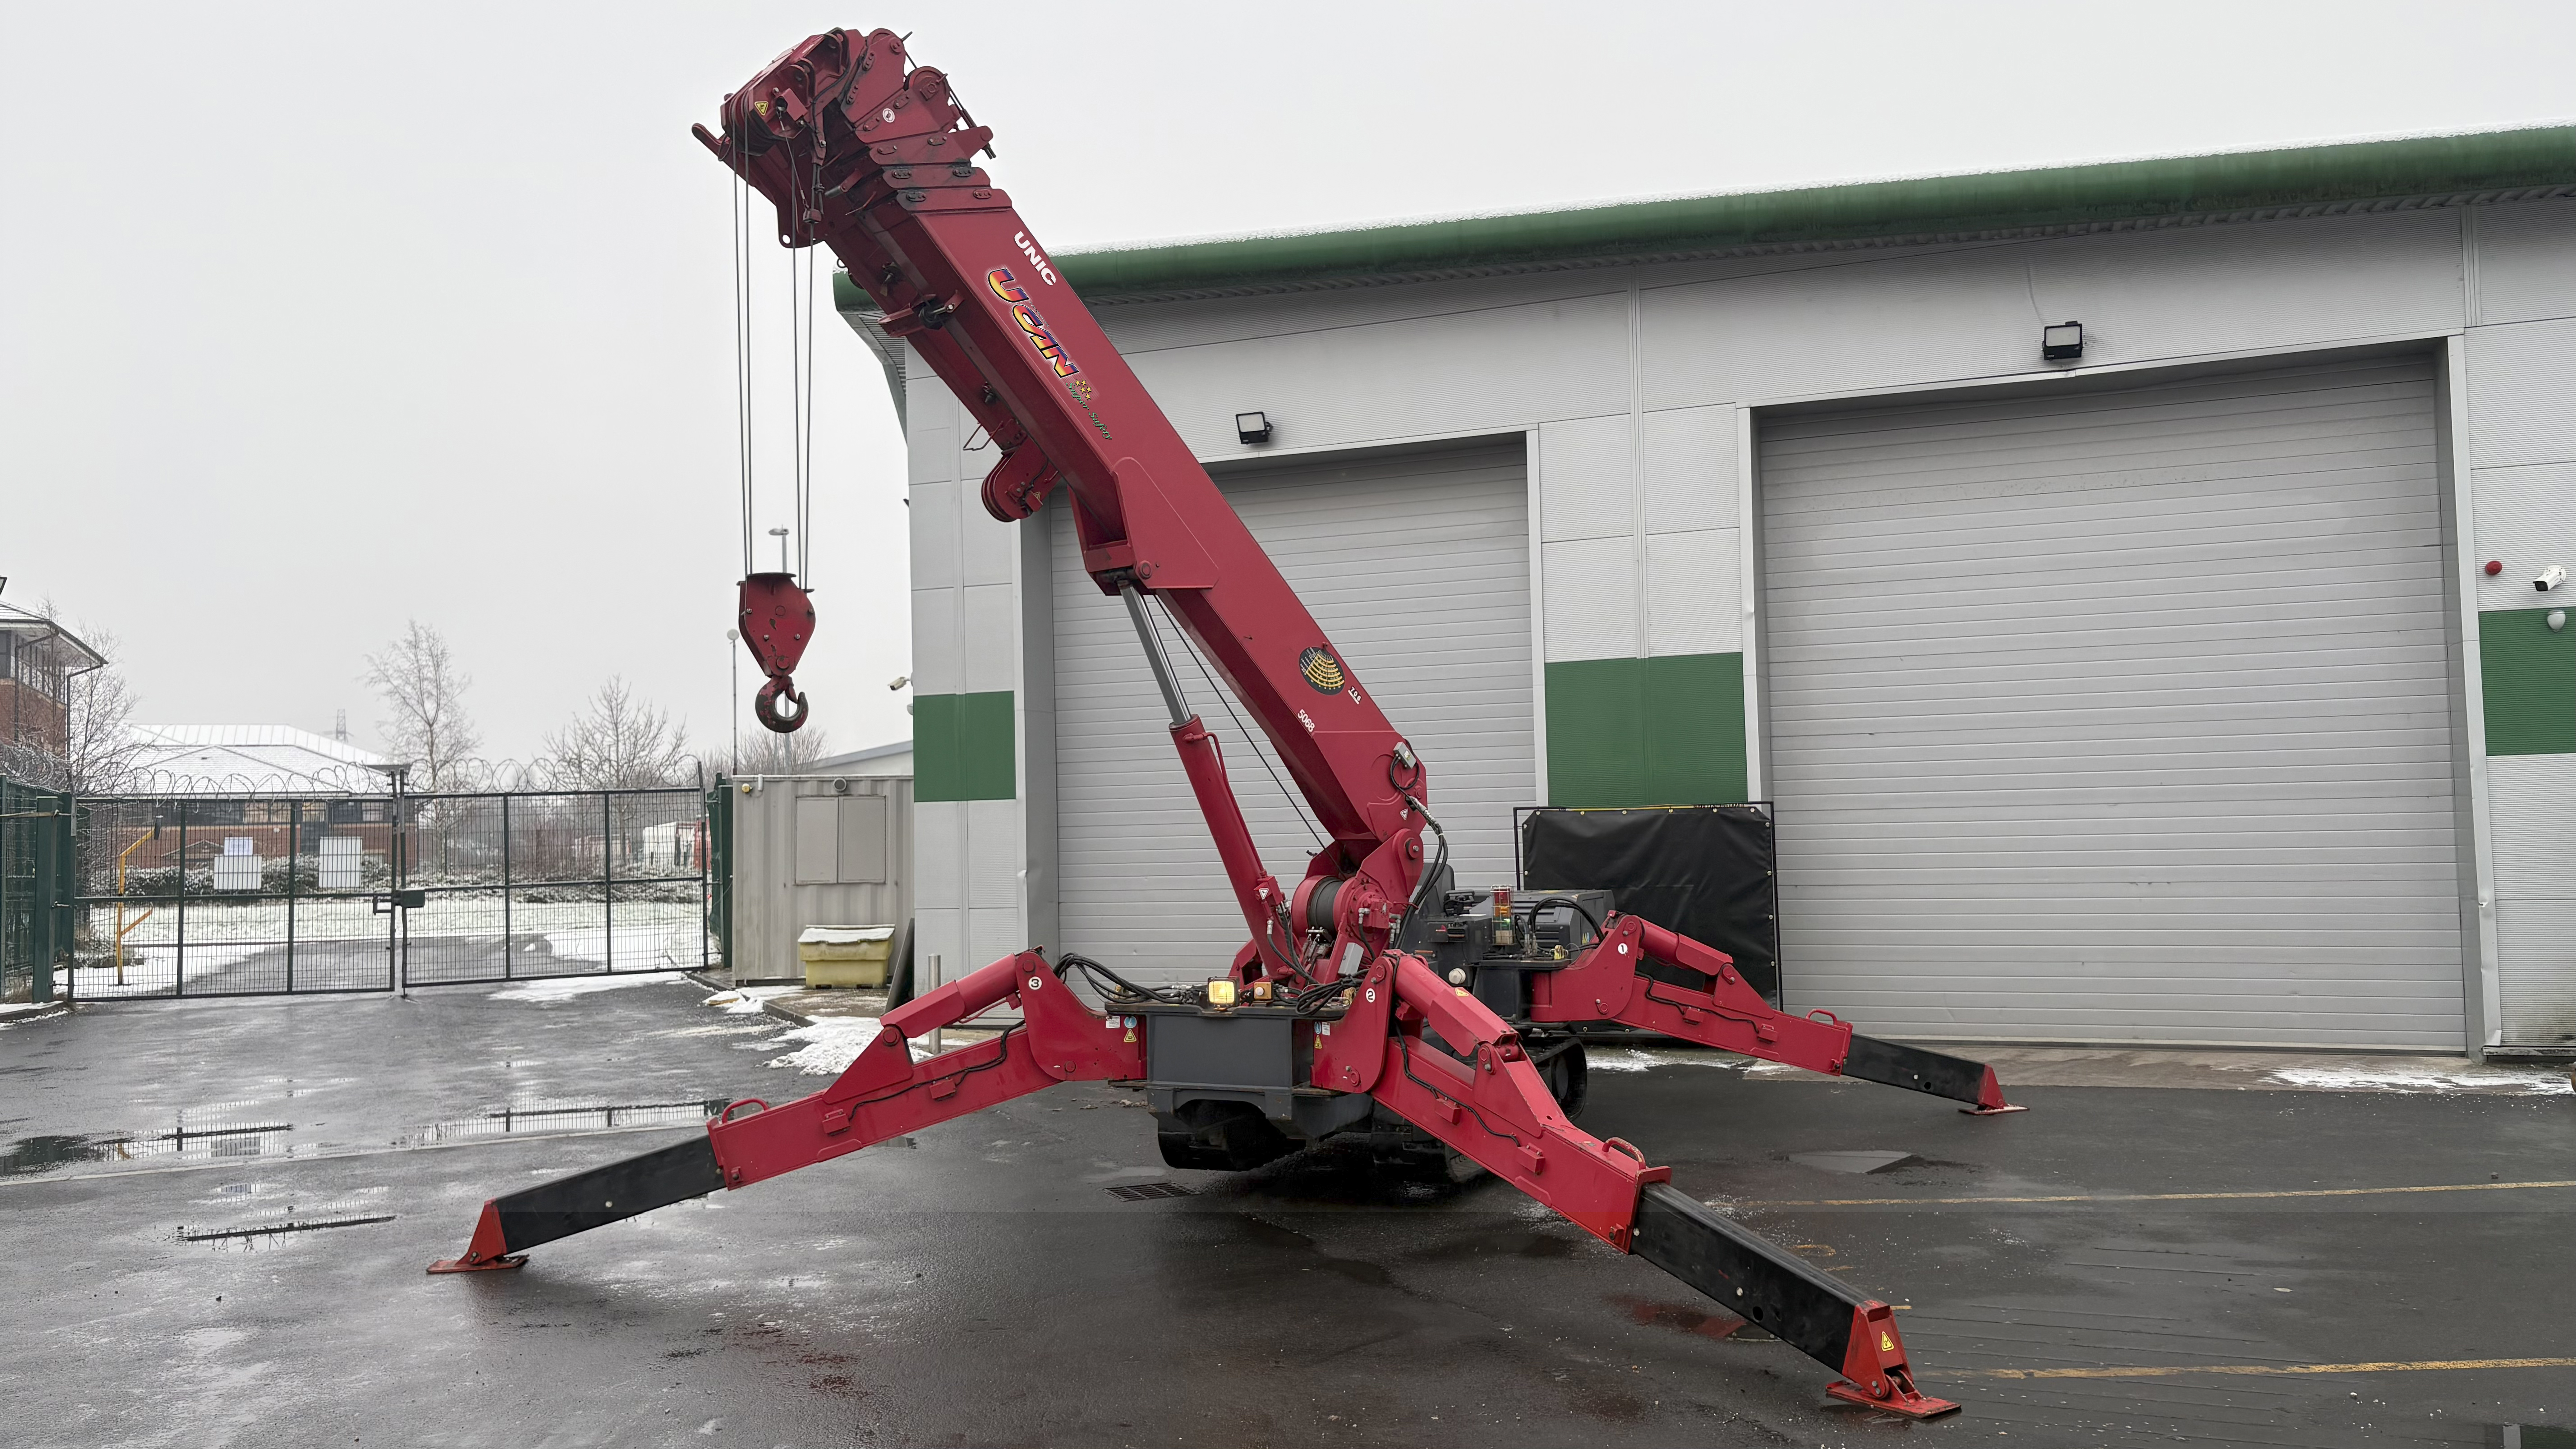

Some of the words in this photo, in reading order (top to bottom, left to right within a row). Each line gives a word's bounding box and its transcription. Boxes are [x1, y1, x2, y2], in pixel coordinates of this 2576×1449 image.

[1014, 230, 1056, 285] UNIC
[988, 268, 1080, 378] UCAN
[1066, 382, 1090, 410] Super
[1088, 412, 1112, 439] Safety
[1297, 709, 1315, 732] 5068
[1031, 979, 1039, 988] 3
[1368, 990, 1374, 1000] 2
